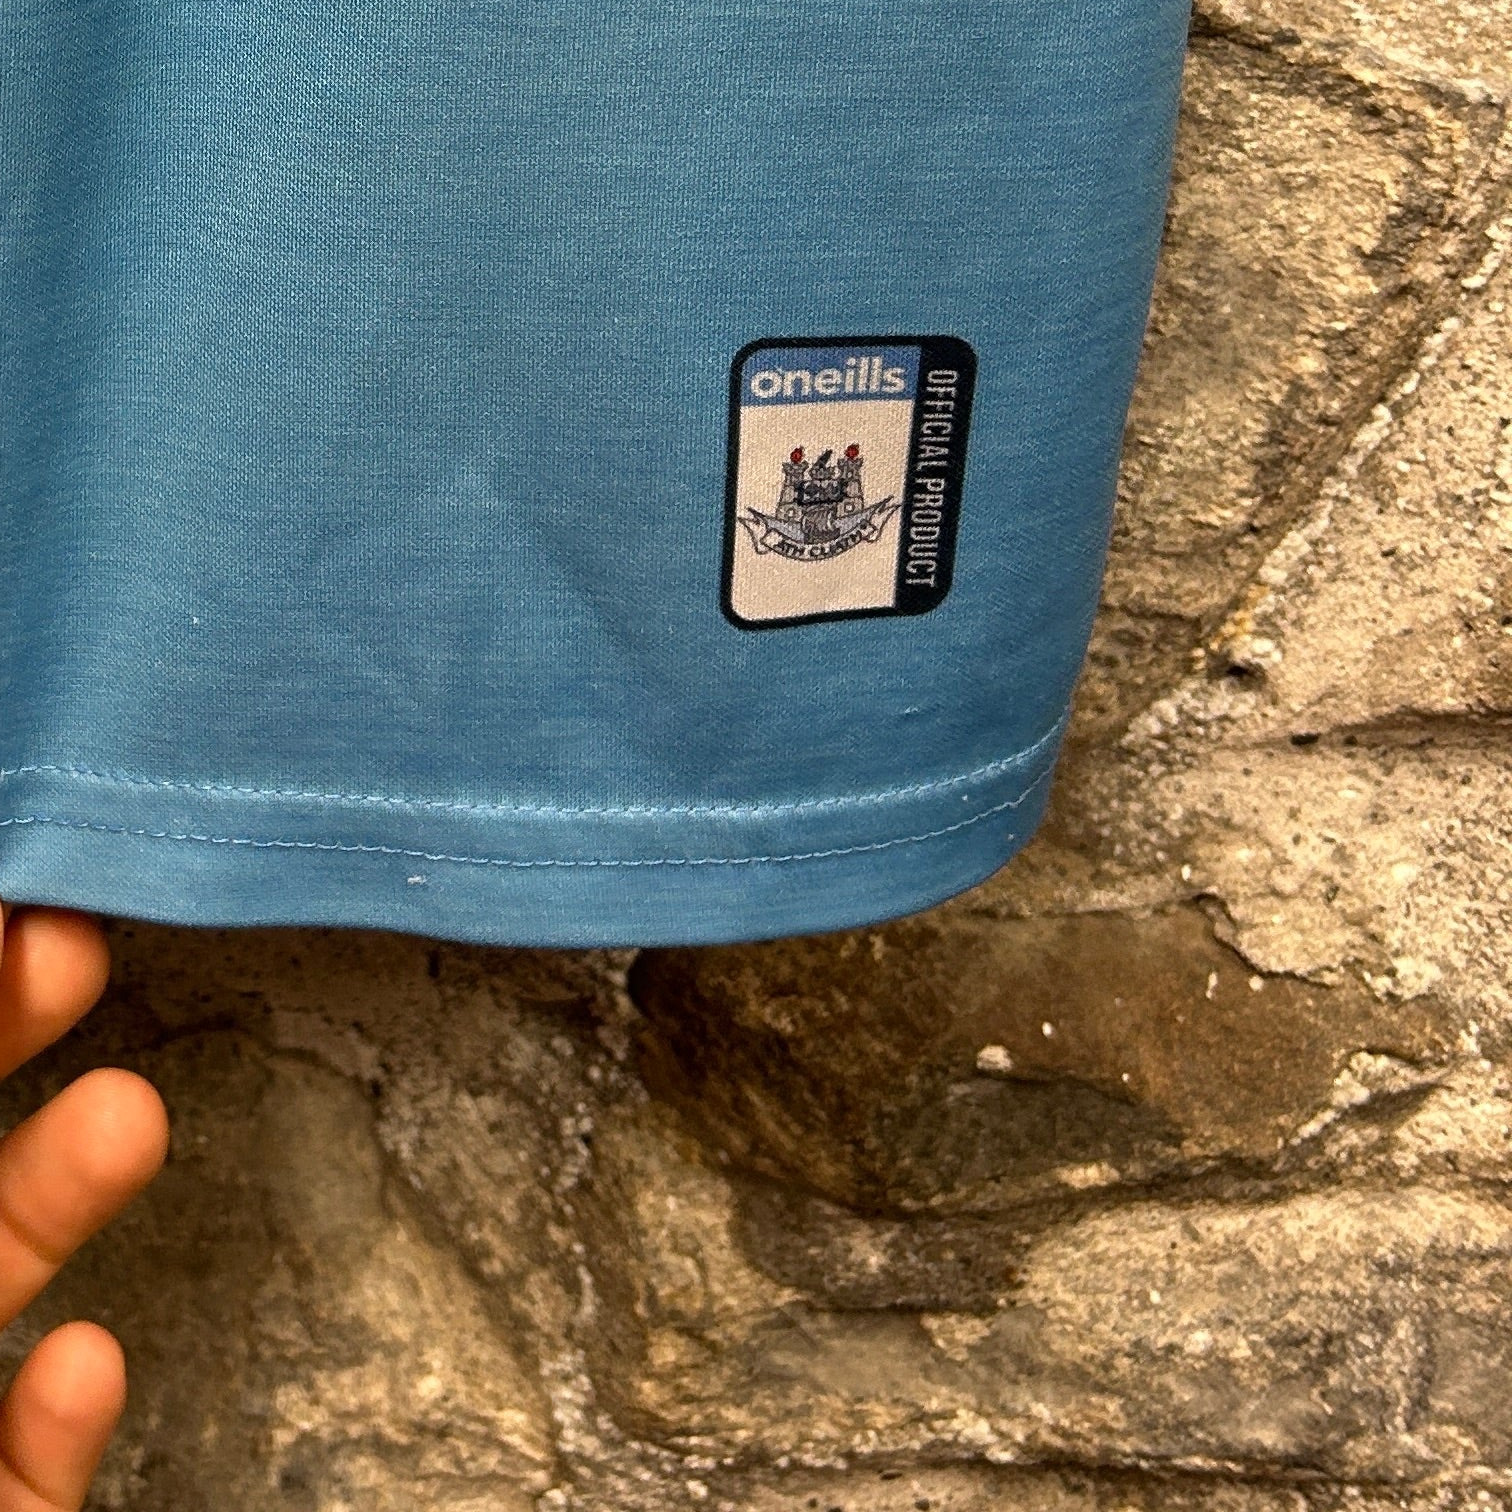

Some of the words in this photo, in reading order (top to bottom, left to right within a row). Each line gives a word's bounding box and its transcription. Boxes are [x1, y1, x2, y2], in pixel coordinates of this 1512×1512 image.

[750, 355, 906, 399] oneills
[915, 369, 960, 472] OFFICIAL
[905, 477, 946, 588] PRODUCT
